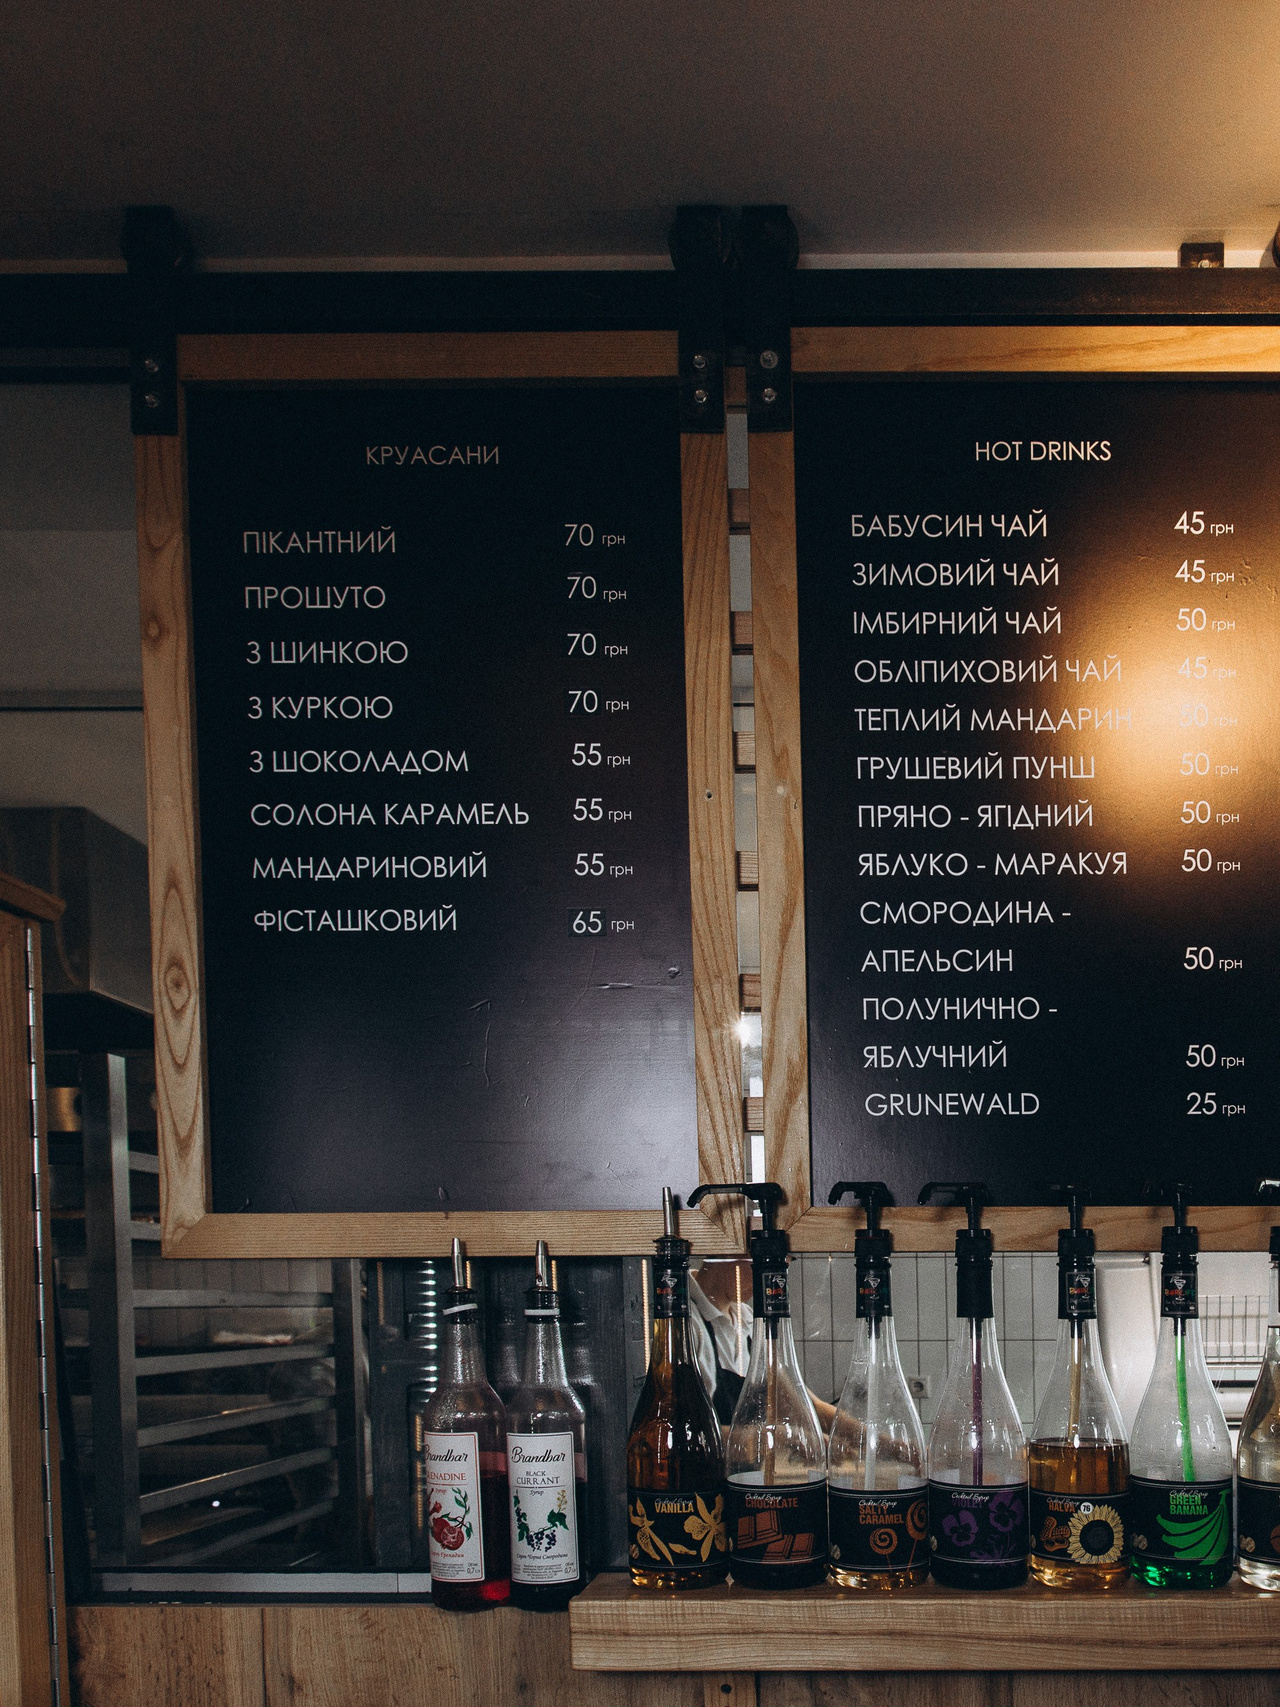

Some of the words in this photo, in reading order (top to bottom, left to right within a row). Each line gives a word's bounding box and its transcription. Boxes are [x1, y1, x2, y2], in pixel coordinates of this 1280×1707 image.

[367, 446, 499, 465] КРУАСАНИ
[976, 441, 1022, 461] HOT
[1031, 441, 1111, 461] DRINKS
[852, 514, 982, 537] БАБУСИН
[991, 510, 1046, 537] ЧАЙ
[1175, 511, 1204, 534] 45
[1210, 524, 1233, 536] грн
[244, 526, 395, 553] ПІКАНТНИЙ
[565, 524, 594, 546] 70
[602, 535, 625, 547] грн
[853, 559, 994, 586] ЗИМОВИЙ
[1003, 558, 1058, 585] ЧАЙ
[1175, 560, 1205, 582] 45
[1211, 571, 1234, 584] грн
[245, 586, 386, 609] ПРОШУТО
[568, 576, 596, 598] 70
[603, 590, 626, 602] грн
[854, 607, 996, 634] ІМБИРНИЙ
[1006, 606, 1061, 634] ЧАЙ
[1176, 608, 1207, 630] 50
[1212, 620, 1235, 632] грн
[271, 641, 408, 663] ШИНКОЮ
[568, 633, 596, 655] 70
[605, 645, 628, 657] грн
[854, 655, 1057, 683] ОБЛІПИХОВИЙ
[1066, 655, 1121, 682] ЧАЙ
[1178, 656, 1207, 679] 45
[1213, 668, 1236, 680] грн
[273, 696, 393, 719] КУРКОЮ
[569, 690, 598, 713] 70
[606, 701, 629, 712] грн
[855, 704, 960, 731] ТЕПЛИЙ
[971, 708, 1132, 734] МАНДАРИН
[1214, 716, 1237, 728] грн
[273, 750, 468, 774] ШОКОЛАДОМ
[572, 743, 601, 766] 55
[607, 756, 630, 767] грн
[857, 752, 1002, 779] ГРУШЕВИЙ
[1013, 756, 1095, 779] ПУНШ
[1180, 754, 1210, 776] 50
[1215, 764, 1238, 777] грн
[251, 803, 376, 826] СОЛОНА
[385, 803, 529, 824] КАРАМЕЛЬ
[573, 798, 603, 821] 55
[609, 811, 632, 822] грн
[859, 805, 951, 828] ПРЯНО
[978, 800, 1093, 830] ЯГІДНИЙ
[1180, 801, 1211, 823] 50
[1216, 812, 1239, 824] грн
[253, 852, 486, 881] МАНДАРИНОВИЙ
[575, 853, 604, 876] 55
[610, 866, 633, 877] грн
[859, 853, 968, 876] ЯБЛУКО
[995, 852, 1127, 875] МАРАКУЯ
[1182, 849, 1212, 872] 50
[1217, 861, 1240, 873] грн
[255, 905, 456, 931] ФІСТАШКОВИЙ
[573, 911, 601, 933] 65
[611, 921, 634, 932] грн
[860, 901, 1053, 926] СМОРОДИНА
[861, 949, 1012, 972] АПЕЛЬСИН
[1184, 947, 1214, 969] 50
[1219, 959, 1242, 971] грн
[863, 997, 1039, 1020] ПОЛУНИЧНО
[863, 1041, 1006, 1068] ЯБЛУЧНИЙ
[1186, 1044, 1216, 1067] 50
[1221, 1057, 1244, 1068] грн
[865, 1093, 1039, 1116] GRUNEWALD
[1187, 1092, 1216, 1115] 25
[1222, 1105, 1245, 1116] грн
[511, 1447, 565, 1463] Brandbar
[427, 1471, 467, 1481] RENADINE
[517, 1477, 560, 1485] CURRANT
[655, 1503, 694, 1513] VANILLA
[746, 1498, 798, 1508] CHOCOLATE
[859, 1505, 887, 1515] SALTY
[1170, 1495, 1201, 1505] GREEN
[1170, 1505, 1208, 1515] BANANA
[860, 1514, 904, 1524] CARAMEL
